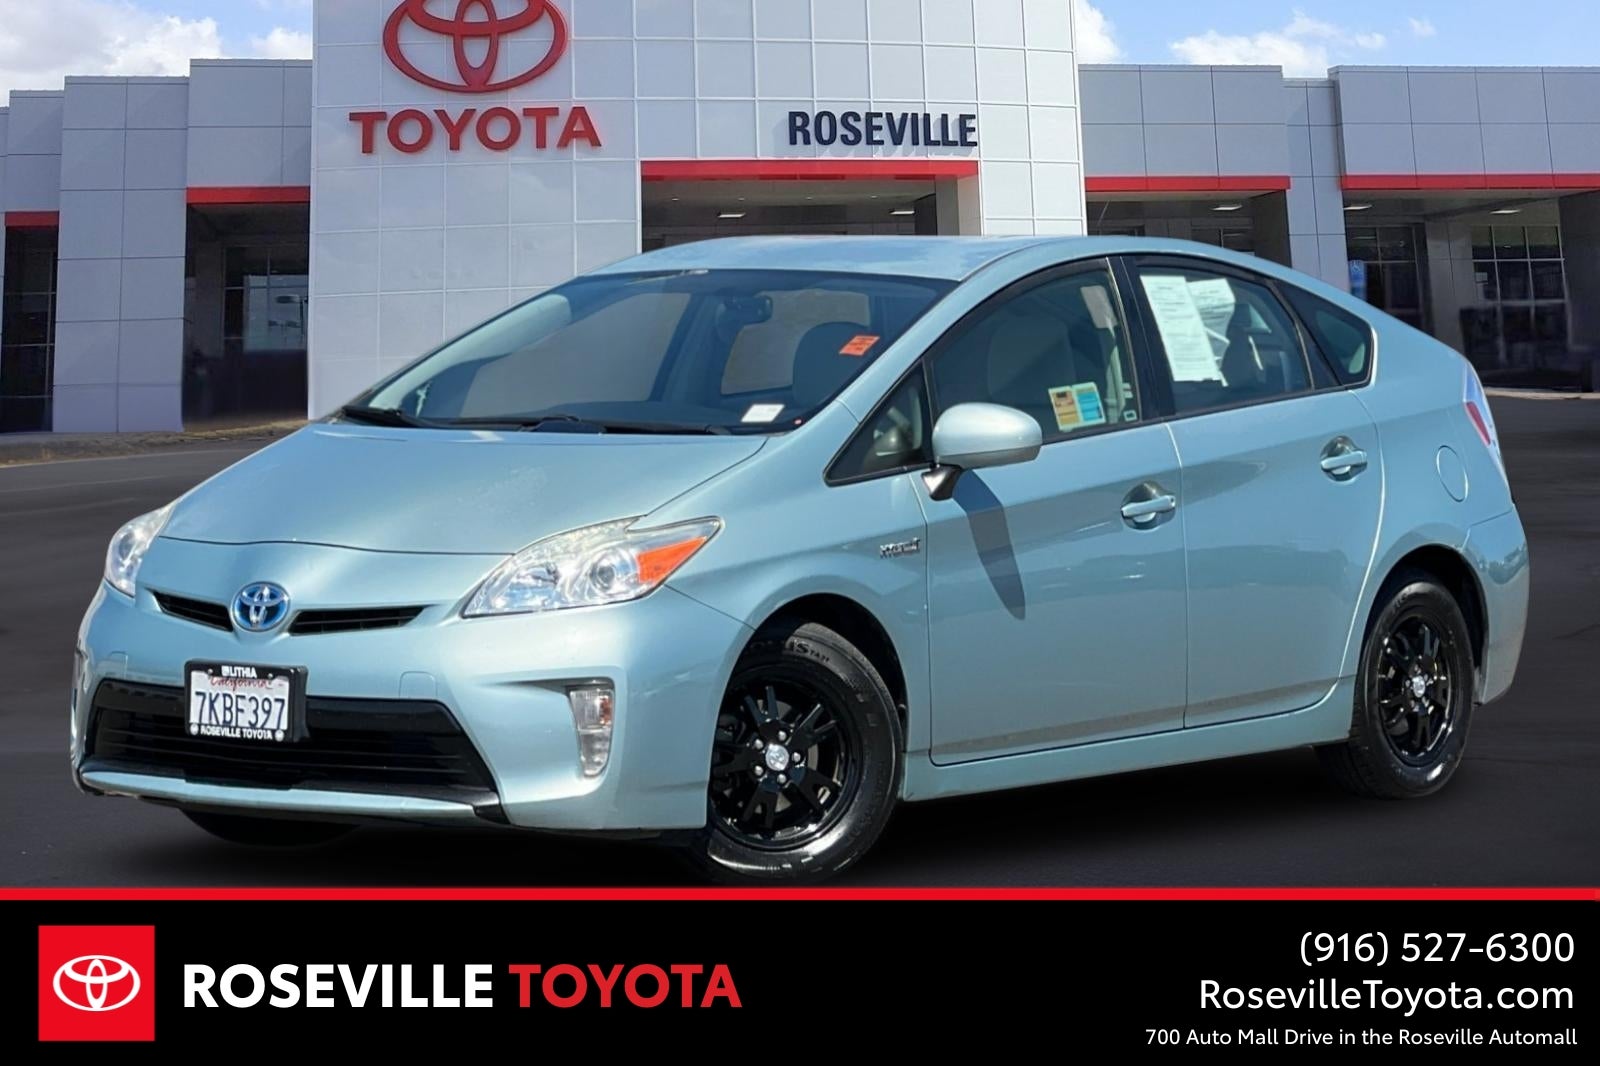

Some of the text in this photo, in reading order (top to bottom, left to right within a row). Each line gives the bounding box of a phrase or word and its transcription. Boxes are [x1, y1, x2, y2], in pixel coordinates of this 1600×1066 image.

[349, 106, 602, 154] TOYOTA
[788, 111, 979, 147] ROSEVILLE
[229, 666, 257, 678] LITHIA
[195, 692, 285, 729] 7KBF397
[201, 726, 273, 739] ROSEVILLE TOYOTA
